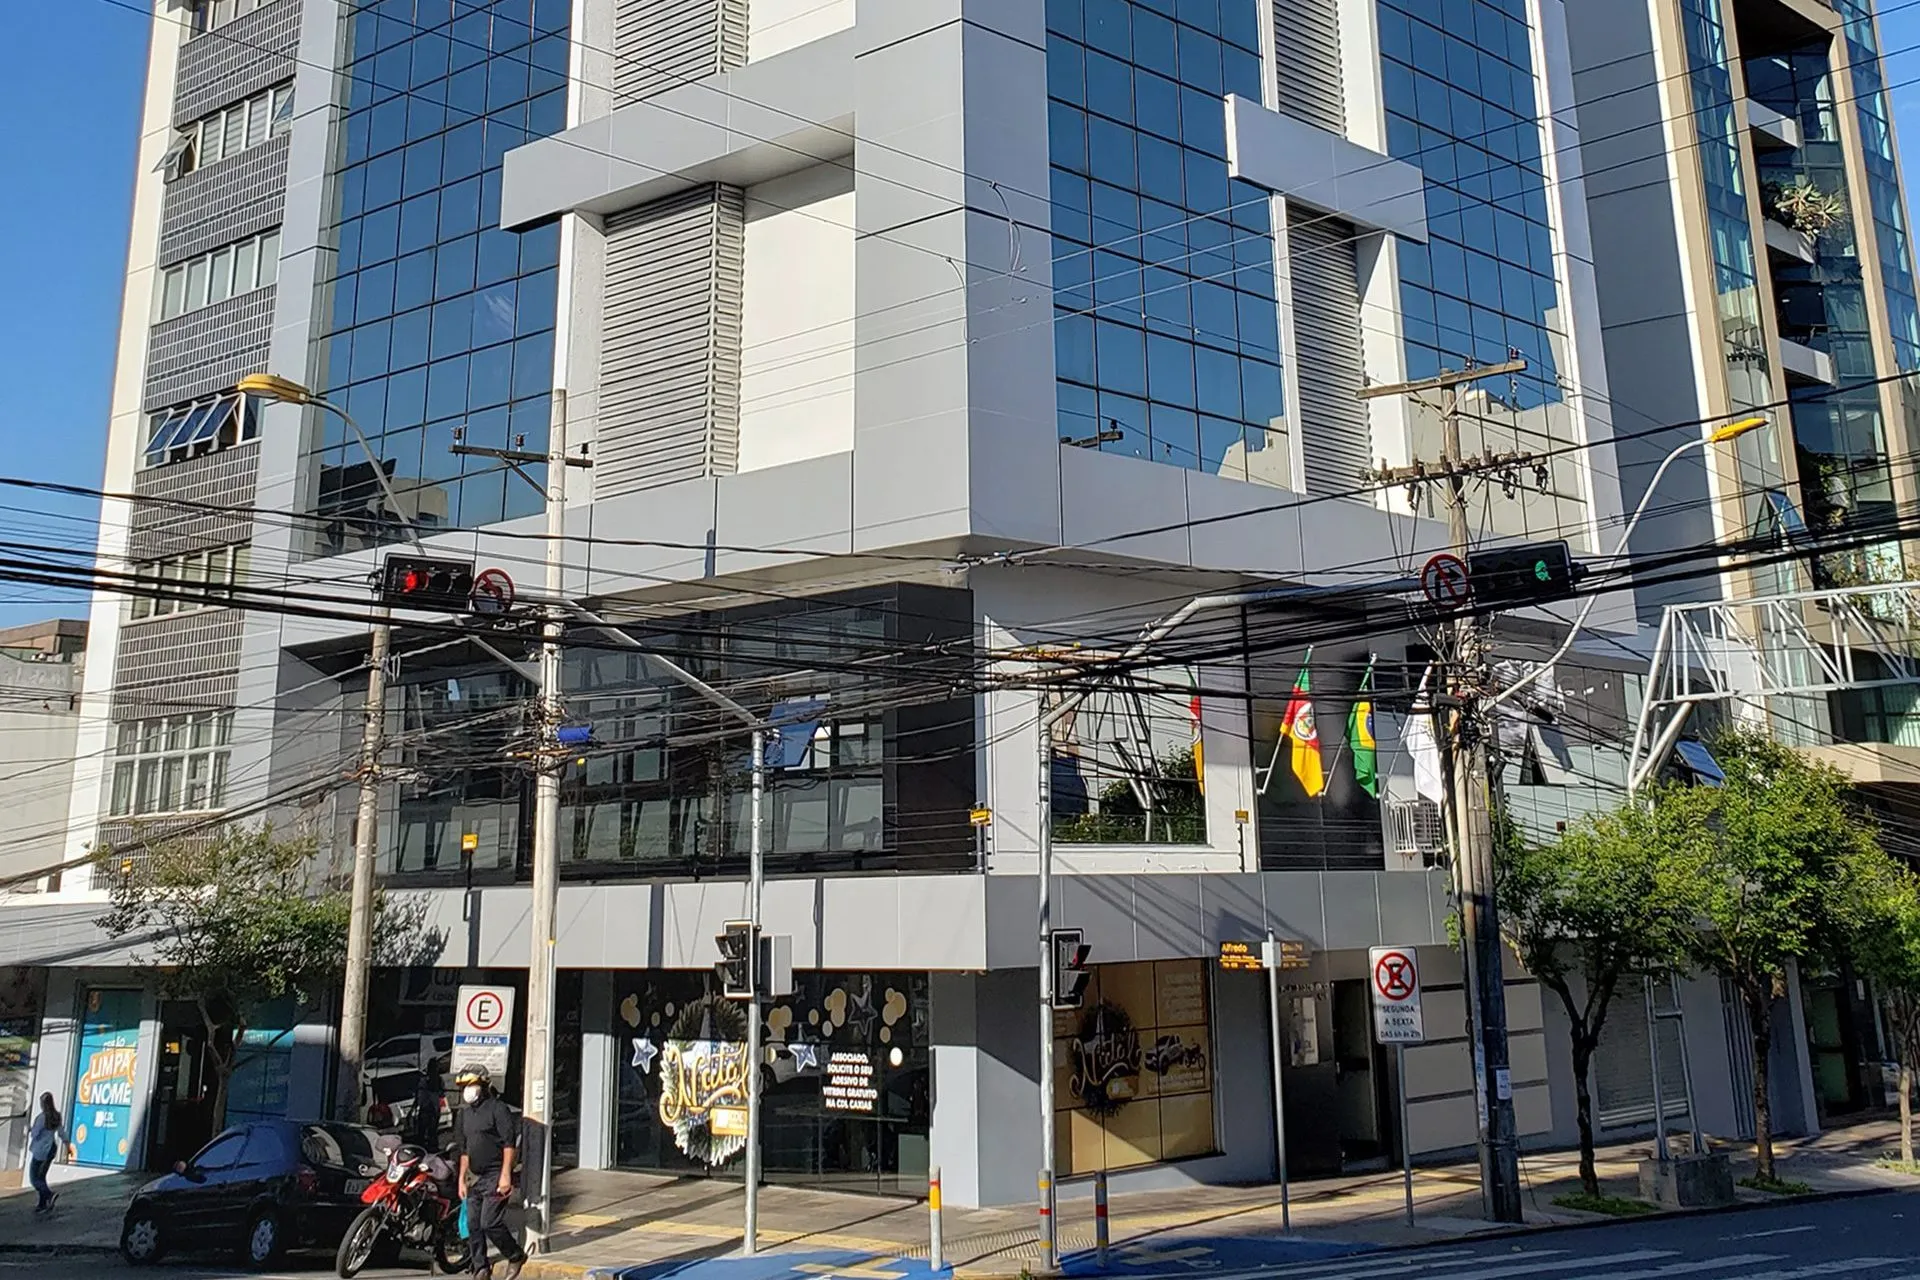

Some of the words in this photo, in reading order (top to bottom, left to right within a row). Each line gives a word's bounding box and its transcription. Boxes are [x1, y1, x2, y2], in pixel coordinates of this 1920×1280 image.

[1221, 943, 1248, 953] Alfredo
[478, 1000, 491, 1022] E
[1382, 1005, 1415, 1013] SEGUNDA
[1393, 1018, 1415, 1026] SEXTA
[484, 1035, 501, 1045] AZUL
[91, 1052, 130, 1079] LIMPA
[827, 1063, 853, 1075] SOLICITE
[854, 1064, 860, 1075] O
[861, 1065, 873, 1076] SEU
[831, 1075, 858, 1086] ADESIVO
[859, 1076, 868, 1087] DE
[90, 1082, 131, 1104] NOME
[823, 1086, 846, 1097] VITRINE
[847, 1087, 878, 1099] GRATUITO
[826, 1098, 835, 1108] NA
[836, 1098, 848, 1109] CDL
[849, 1099, 873, 1110] CAXIAS
